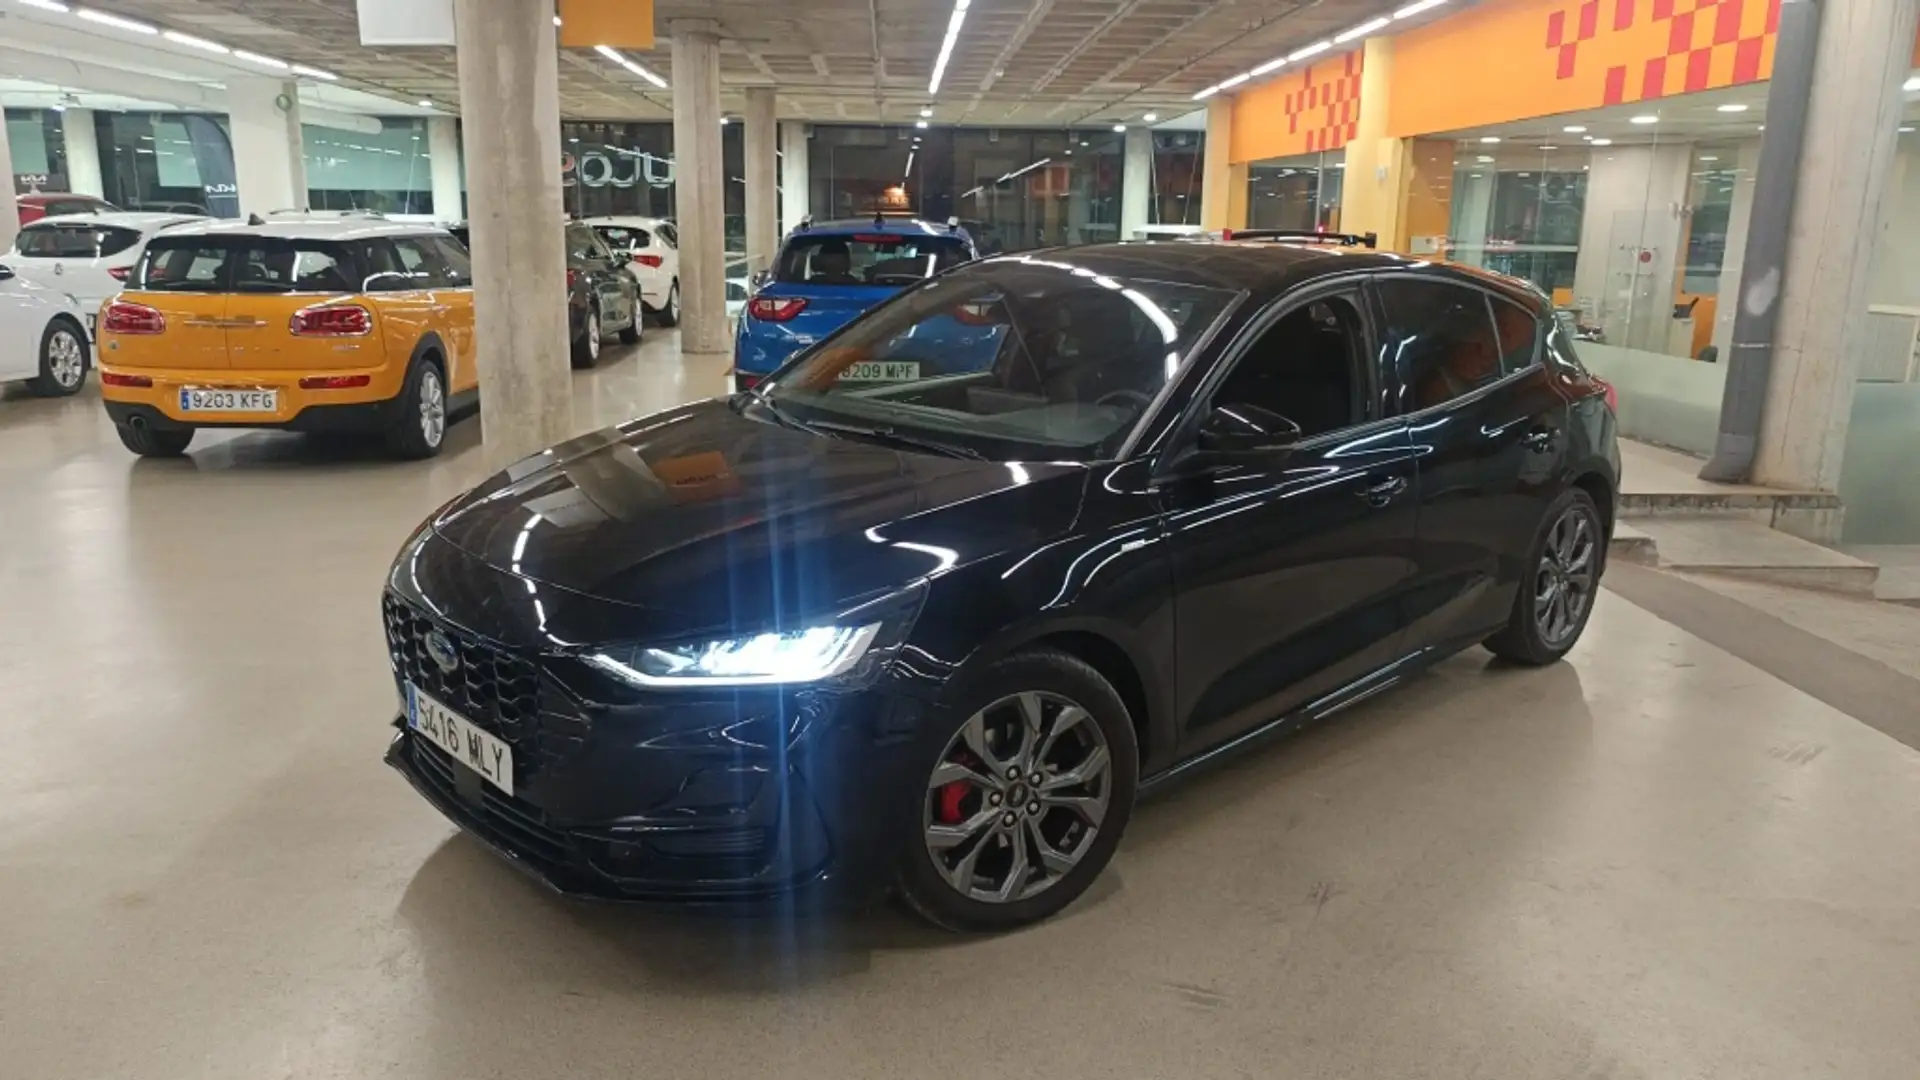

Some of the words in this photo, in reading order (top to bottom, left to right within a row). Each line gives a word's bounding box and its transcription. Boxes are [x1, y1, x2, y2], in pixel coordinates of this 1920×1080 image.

[193, 392, 235, 408] 9203
[240, 393, 273, 409] KFG
[418, 696, 459, 753] 5416
[467, 729, 502, 782] MLY
